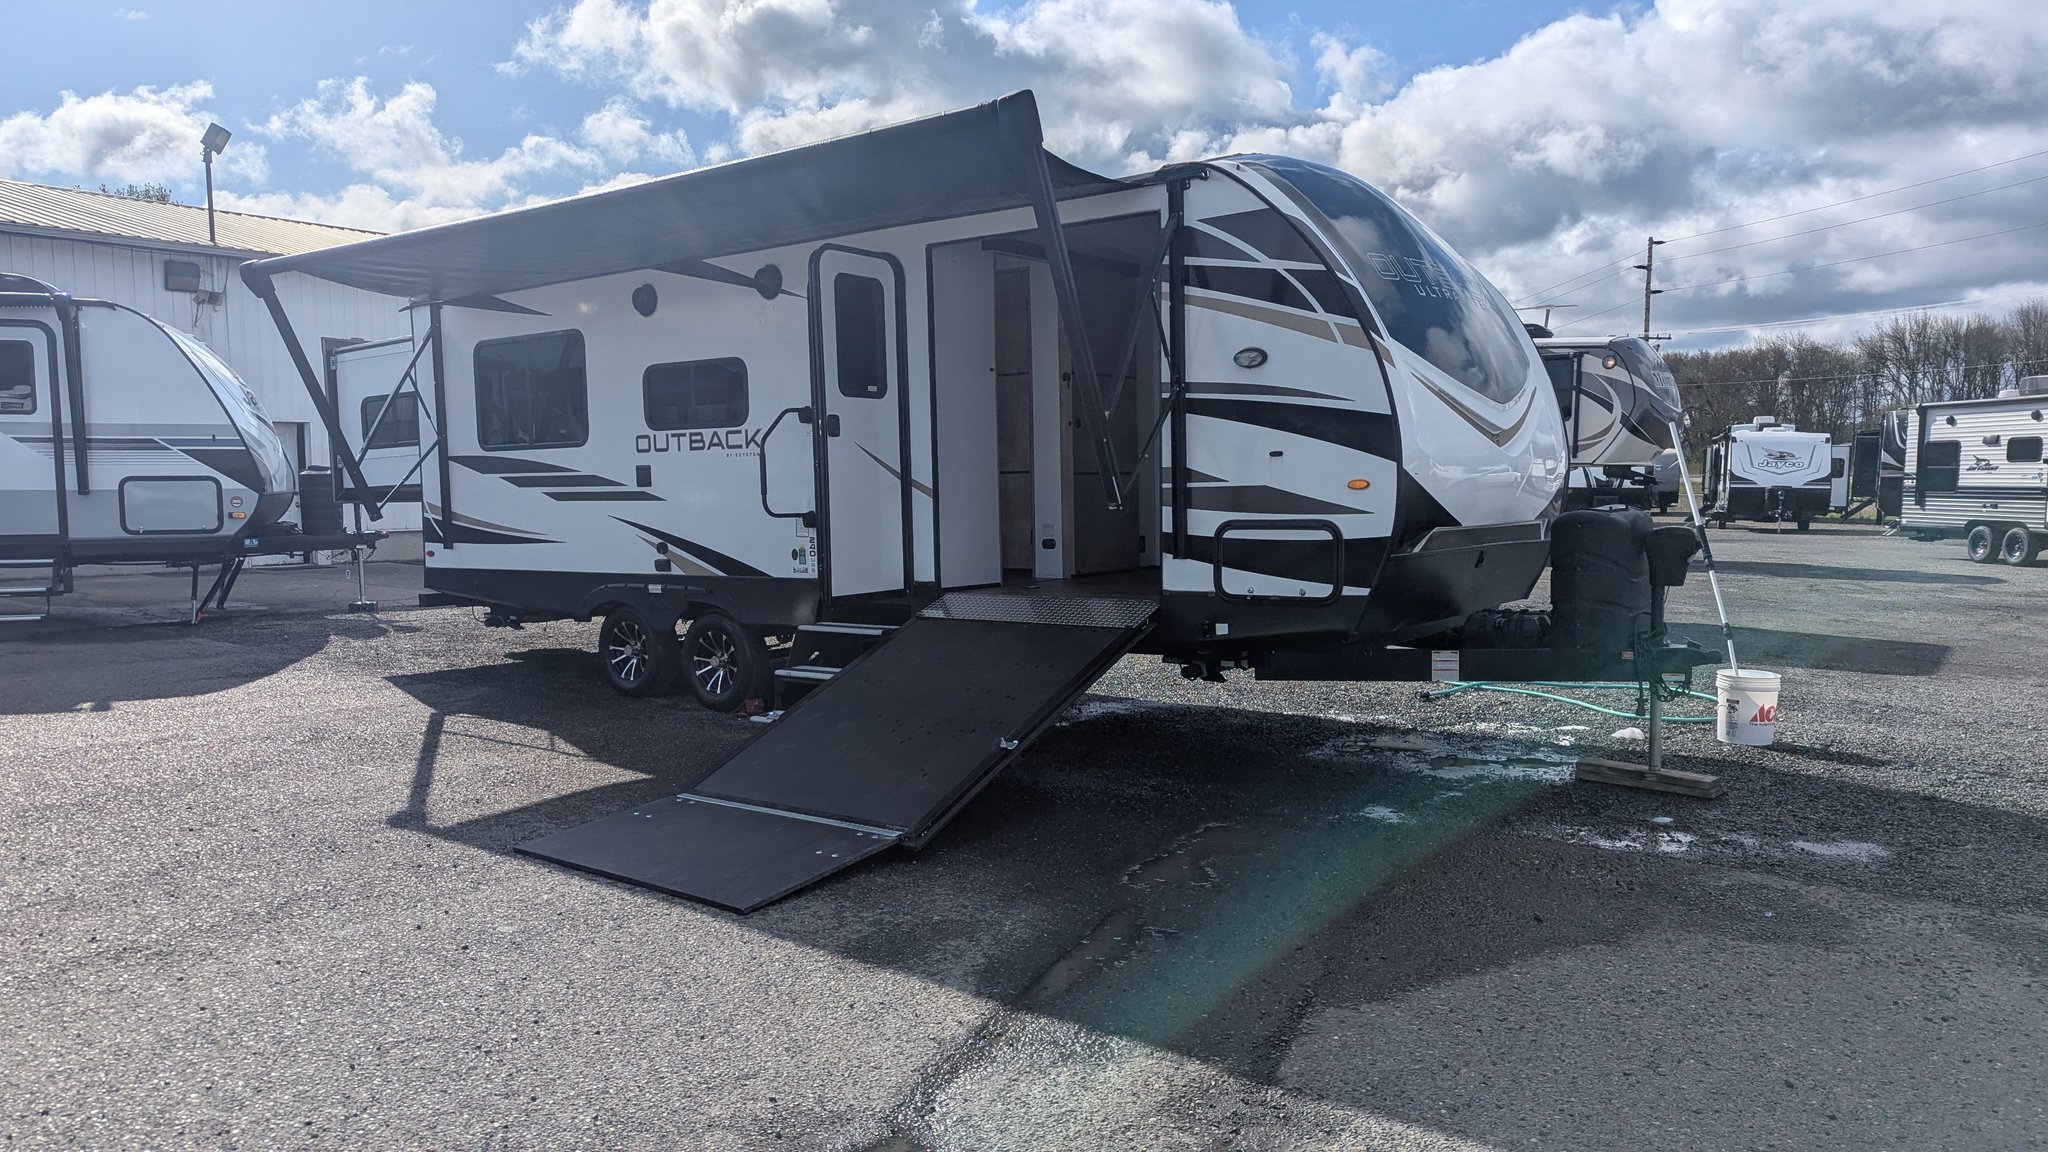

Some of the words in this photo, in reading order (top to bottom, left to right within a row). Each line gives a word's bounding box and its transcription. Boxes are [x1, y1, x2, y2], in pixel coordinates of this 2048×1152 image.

[635, 428, 762, 453] OUTBACK
[1757, 459, 1805, 470] Jayco
[1749, 703, 1777, 723] AC
